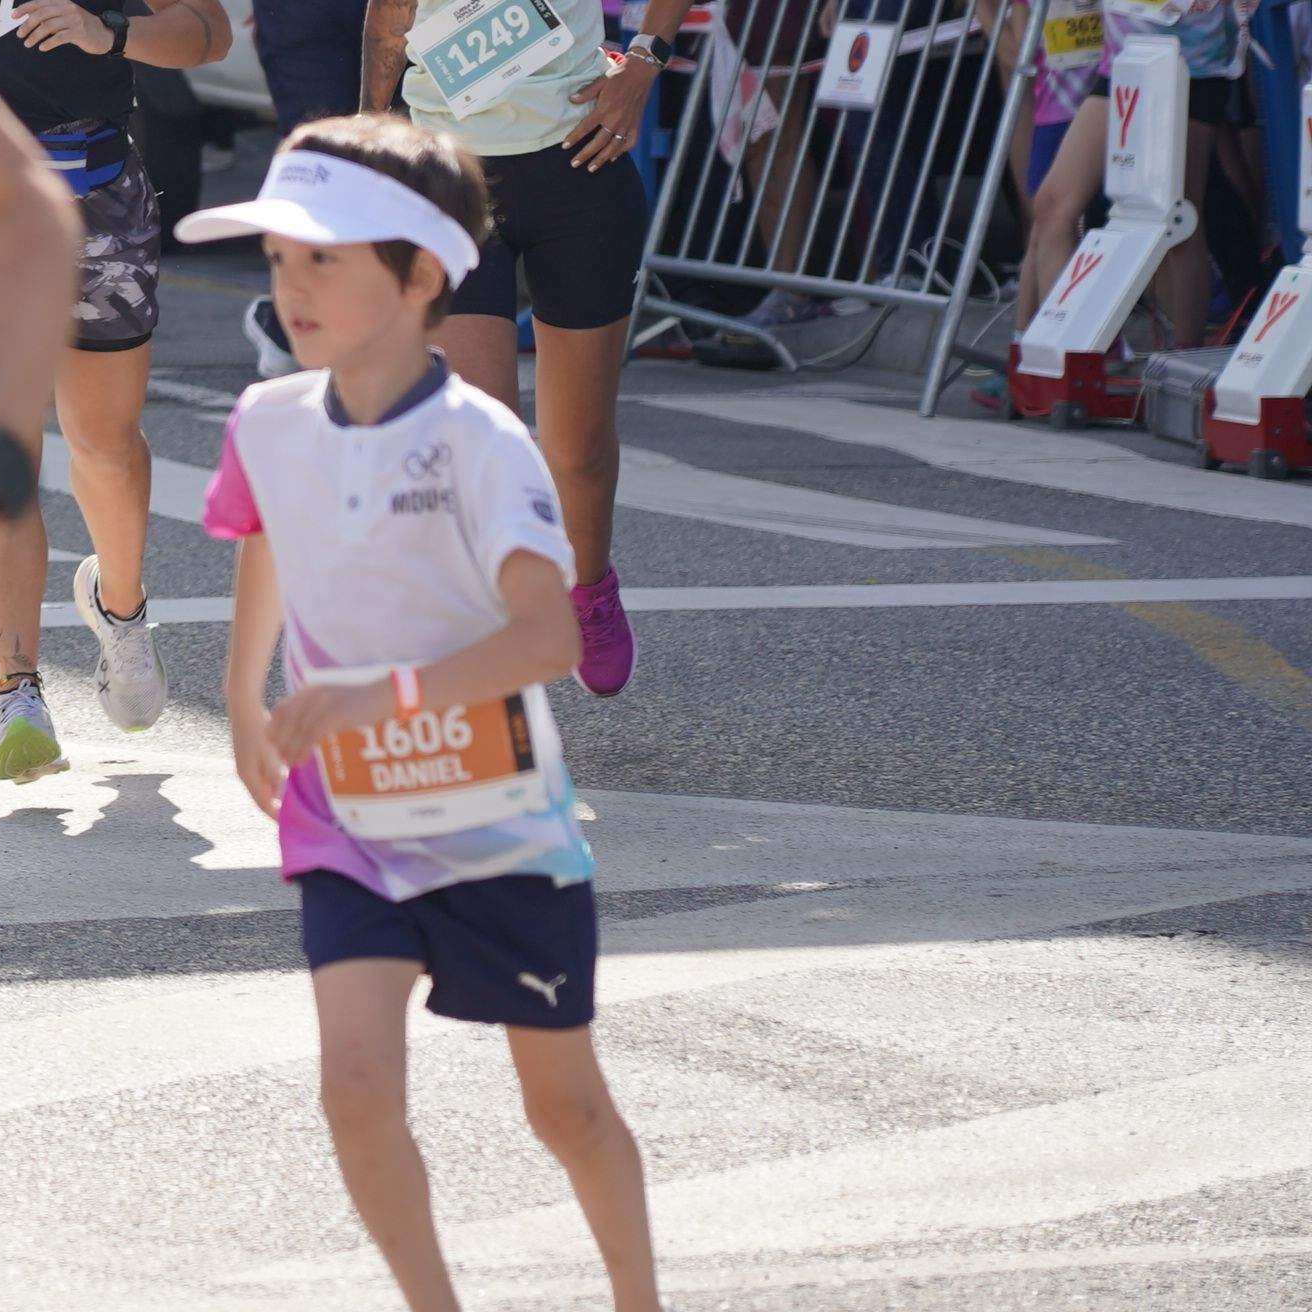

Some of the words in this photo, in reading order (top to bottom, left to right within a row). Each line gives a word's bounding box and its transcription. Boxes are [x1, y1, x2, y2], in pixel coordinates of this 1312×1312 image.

[447, 5, 530, 77] 1249
[356, 703, 474, 761] 1606
[369, 753, 474, 793] DANIEL
